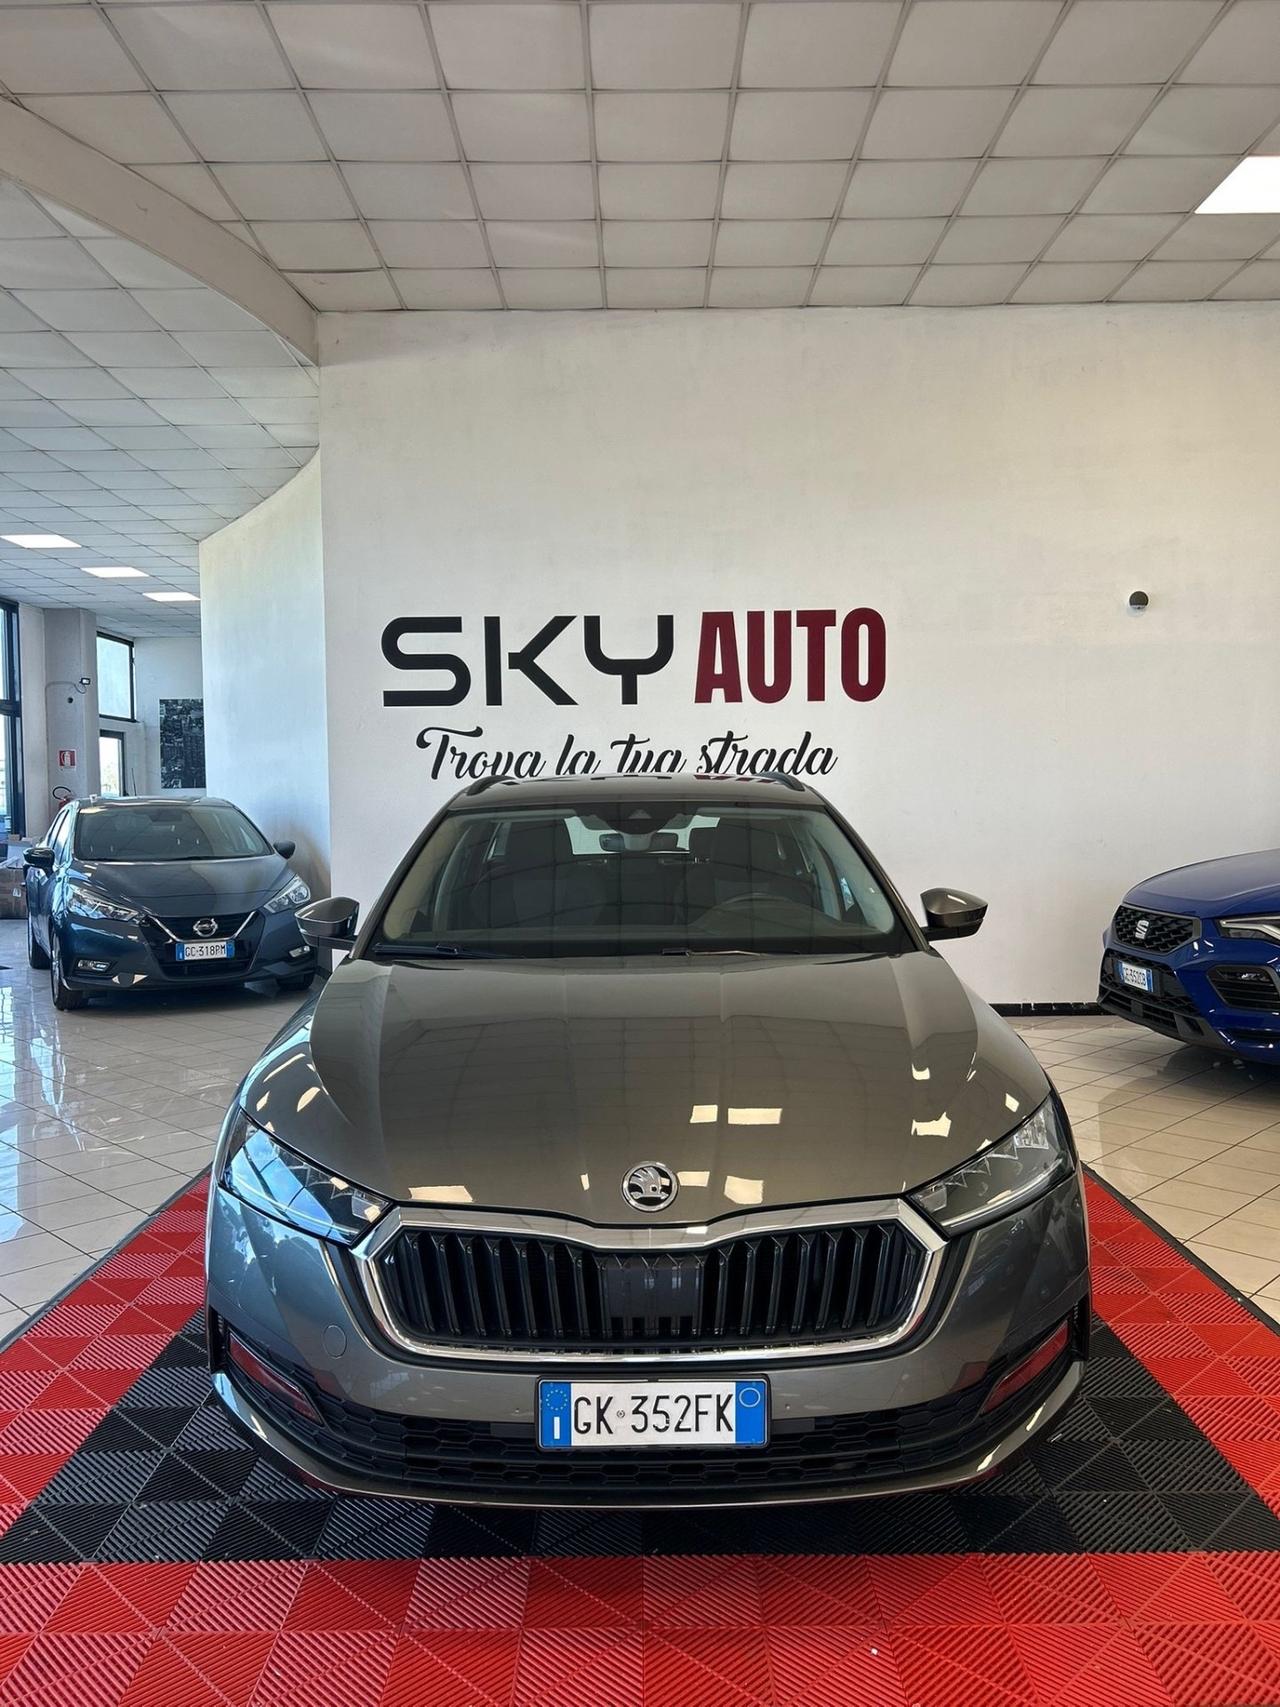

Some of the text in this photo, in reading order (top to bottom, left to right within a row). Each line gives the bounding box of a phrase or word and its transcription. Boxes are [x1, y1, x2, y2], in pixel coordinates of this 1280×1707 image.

[381, 607, 886, 707] SKY AUTO
[416, 726, 838, 780] Trova la tua strada
[574, 1396, 614, 1434] GK
[631, 1394, 734, 1433] 352FK
